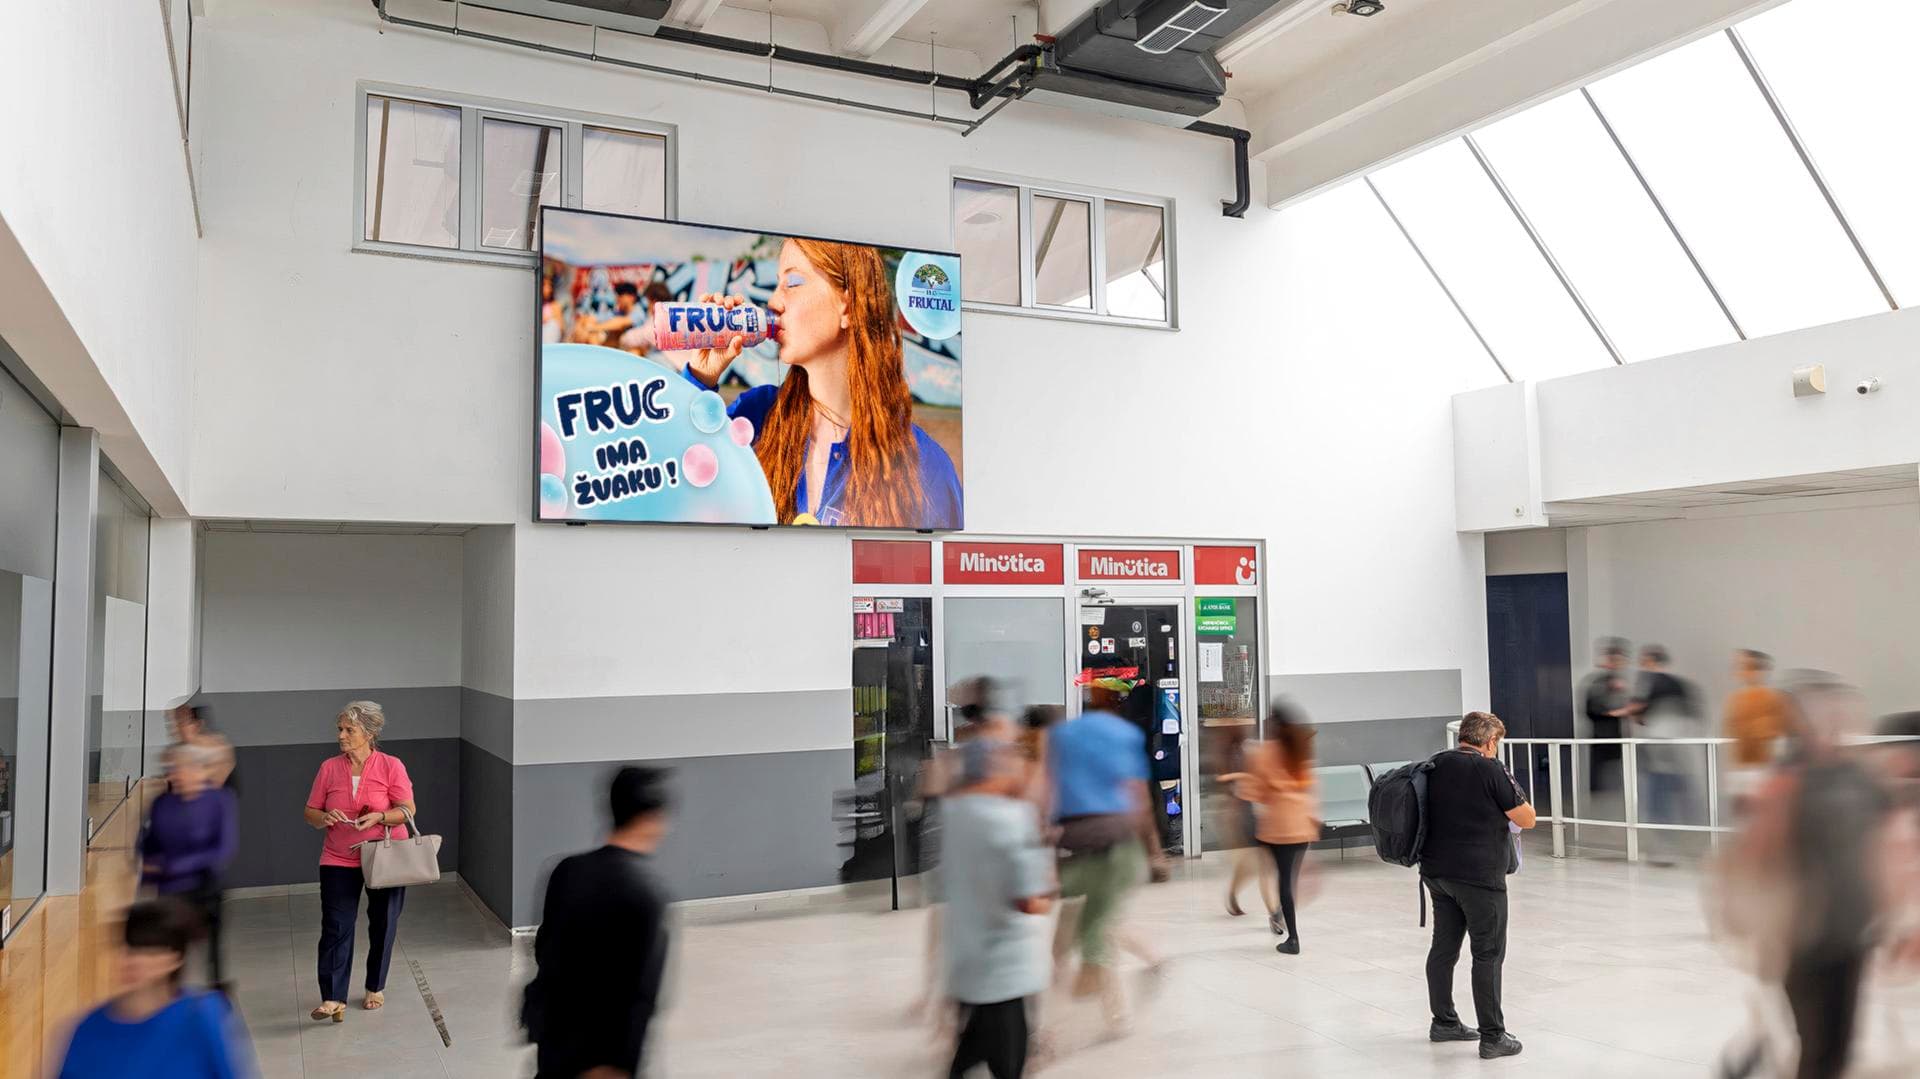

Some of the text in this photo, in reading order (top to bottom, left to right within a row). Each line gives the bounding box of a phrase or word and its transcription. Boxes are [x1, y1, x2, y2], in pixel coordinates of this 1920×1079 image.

[668, 306, 743, 333] FRUC
[908, 295, 956, 312] FRUCTAL
[556, 379, 670, 437] FRUC
[595, 439, 648, 471] IMA
[574, 473, 663, 506] ŽVAKU
